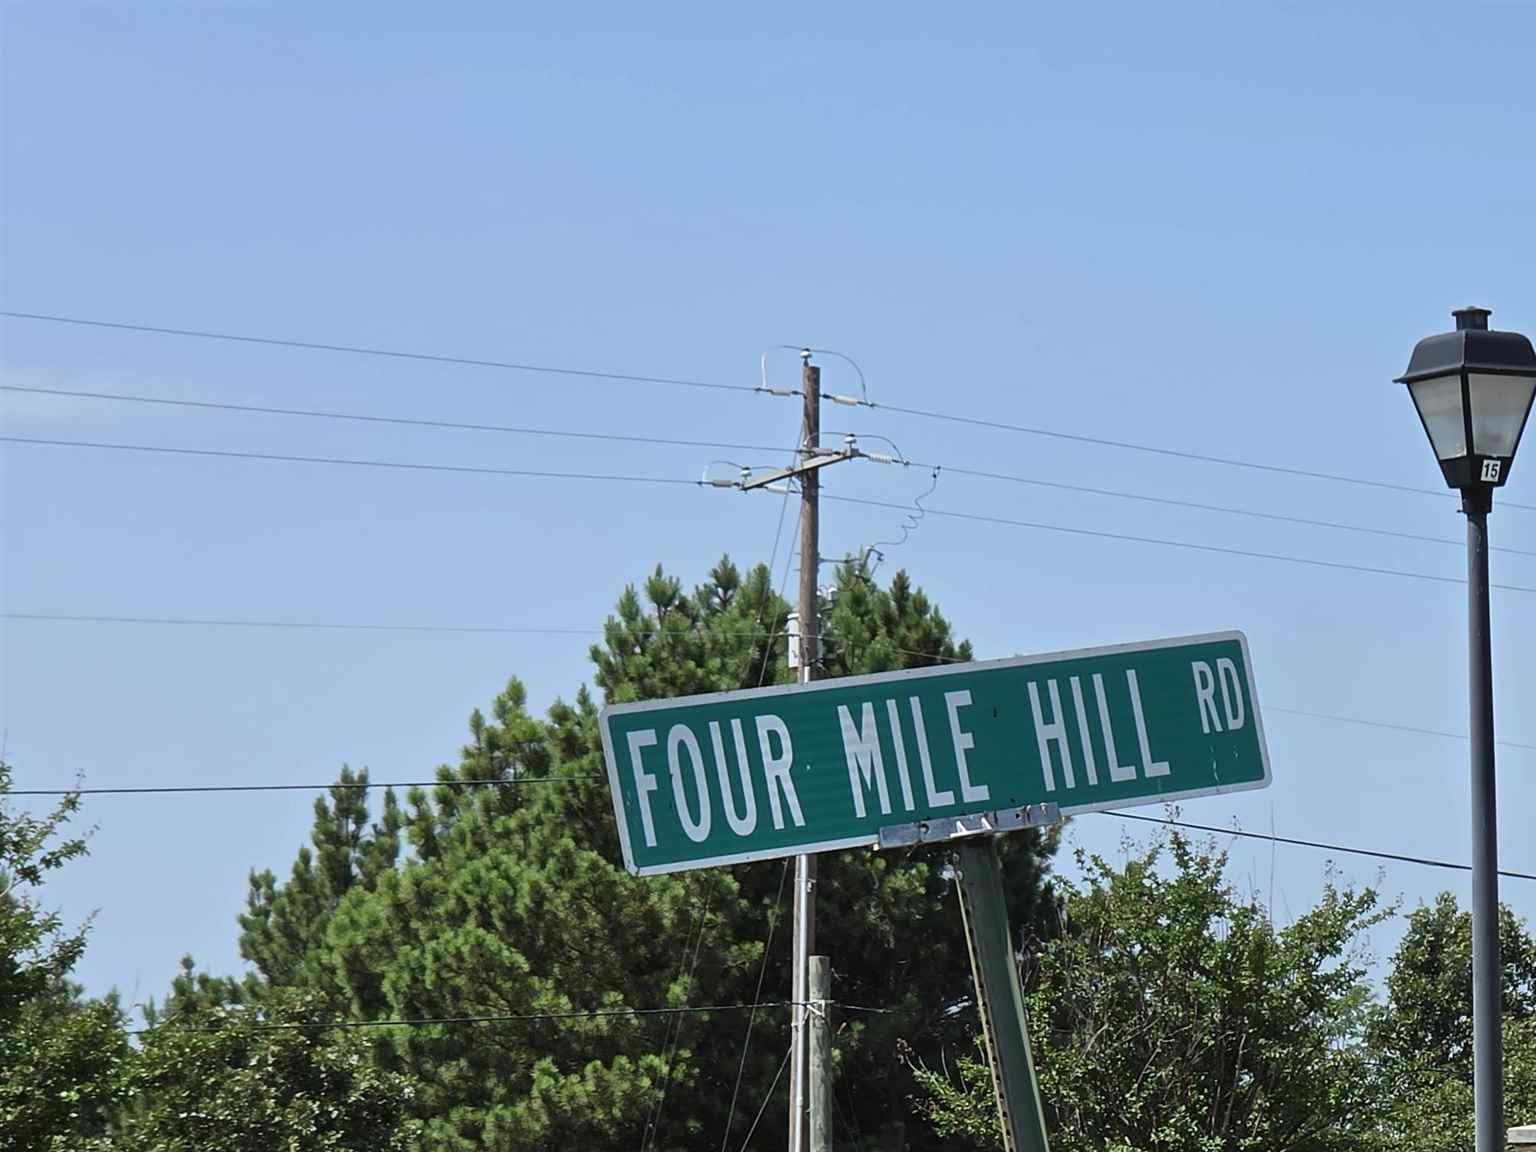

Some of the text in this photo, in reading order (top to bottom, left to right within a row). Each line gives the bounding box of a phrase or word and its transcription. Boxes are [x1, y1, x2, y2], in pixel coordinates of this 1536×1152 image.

[1485, 463, 1498, 478] 15
[626, 657, 1245, 848] FOUR MILE HILL RD
